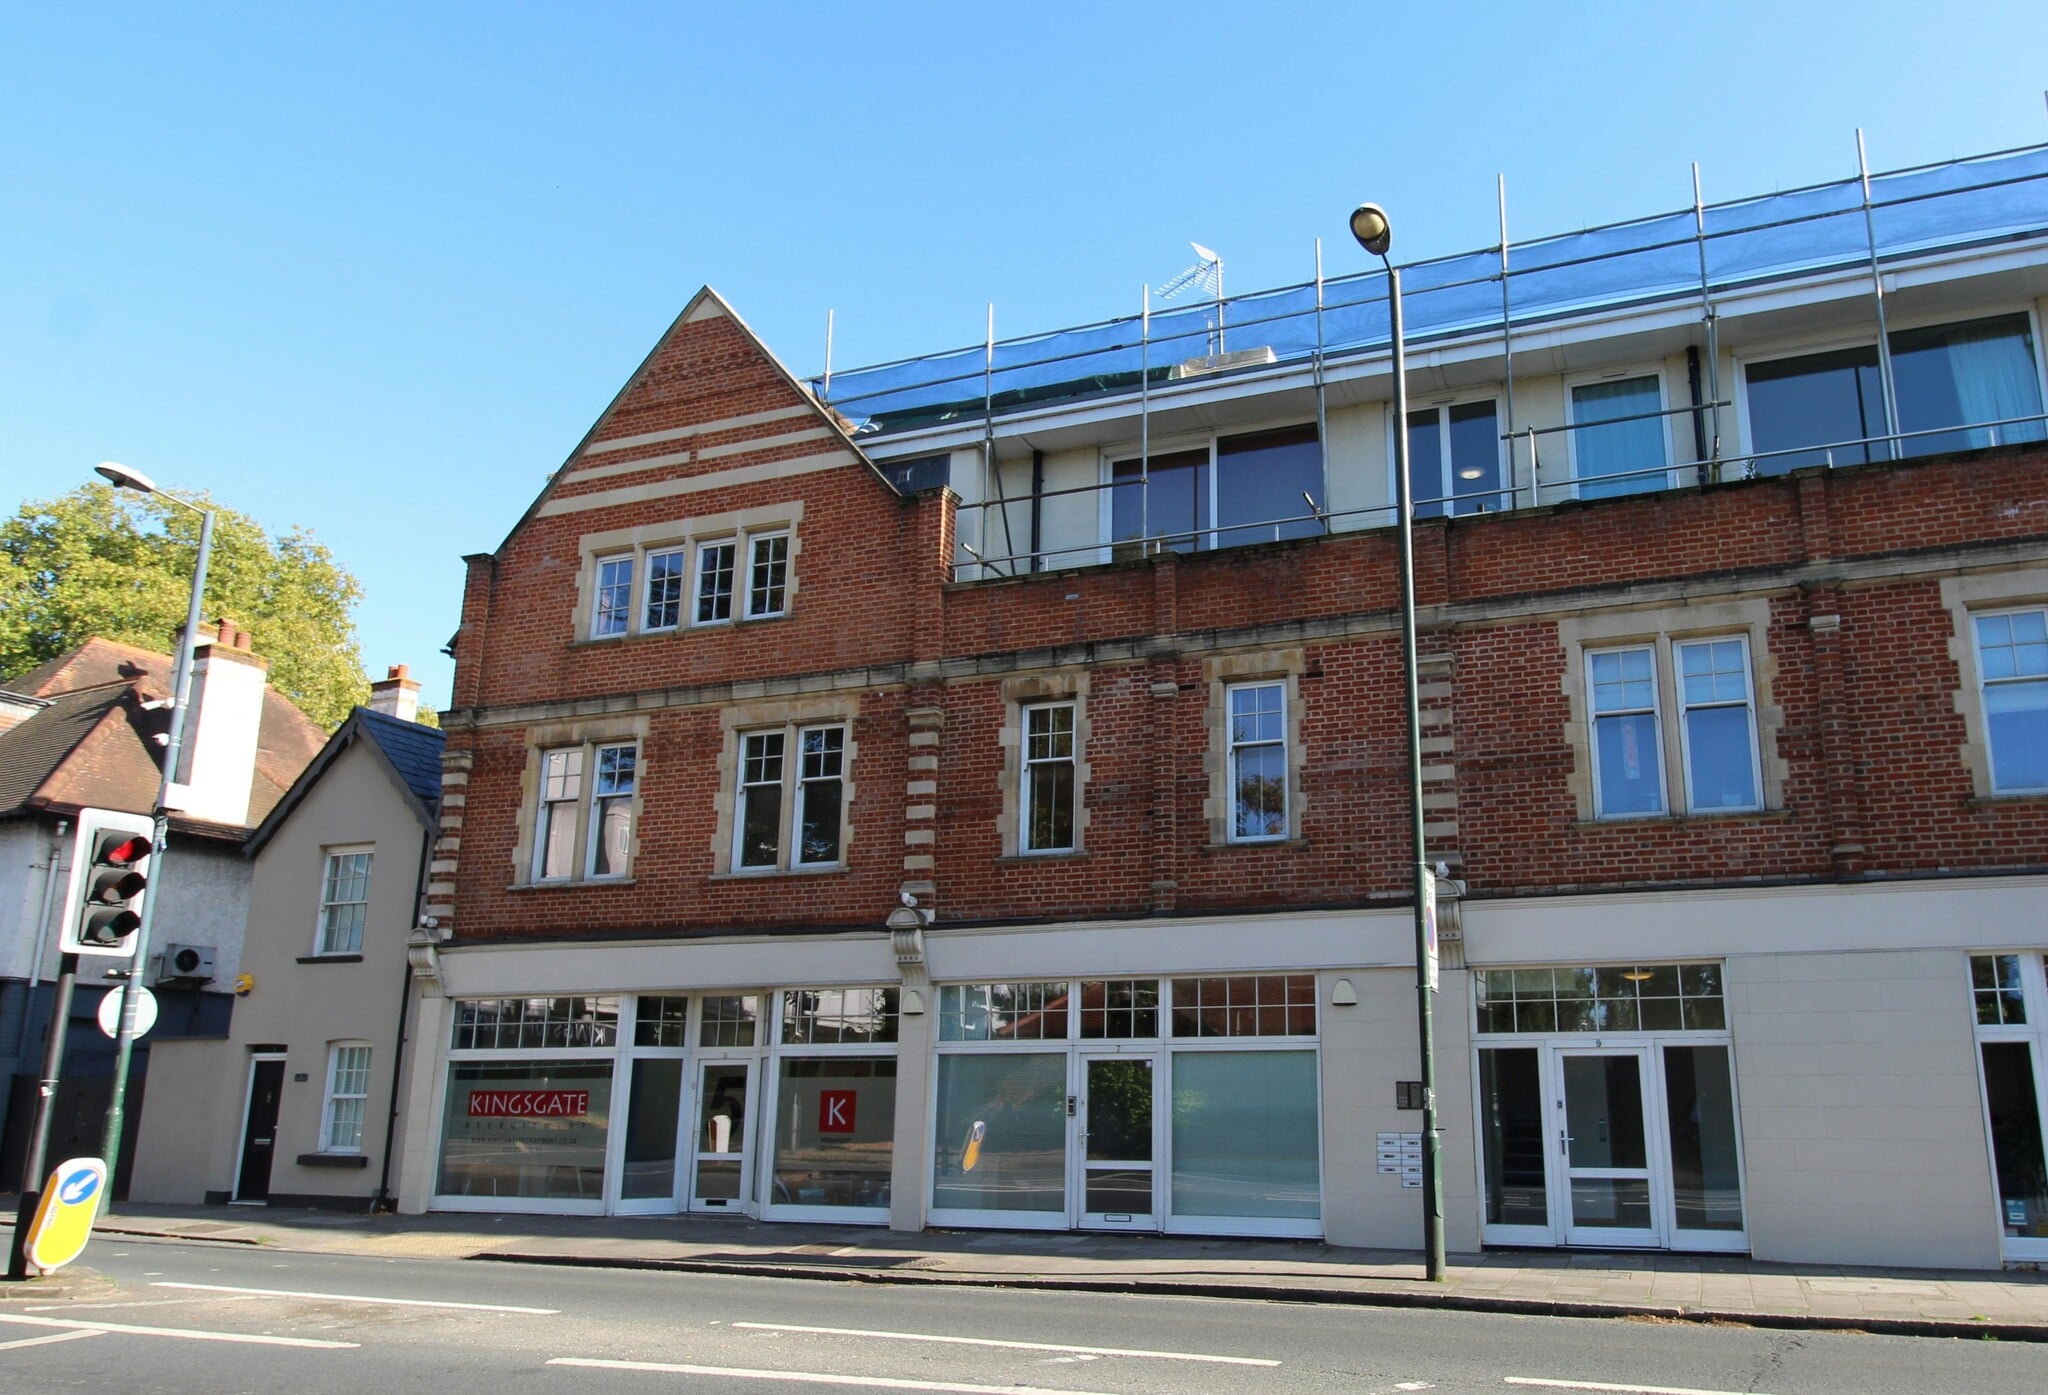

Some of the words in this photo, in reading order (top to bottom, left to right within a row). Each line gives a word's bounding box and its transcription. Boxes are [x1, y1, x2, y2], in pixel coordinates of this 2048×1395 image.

[470, 1094, 586, 1114] KINGSGATE
[705, 1076, 747, 1139] 5
[828, 1097, 846, 1126] K
